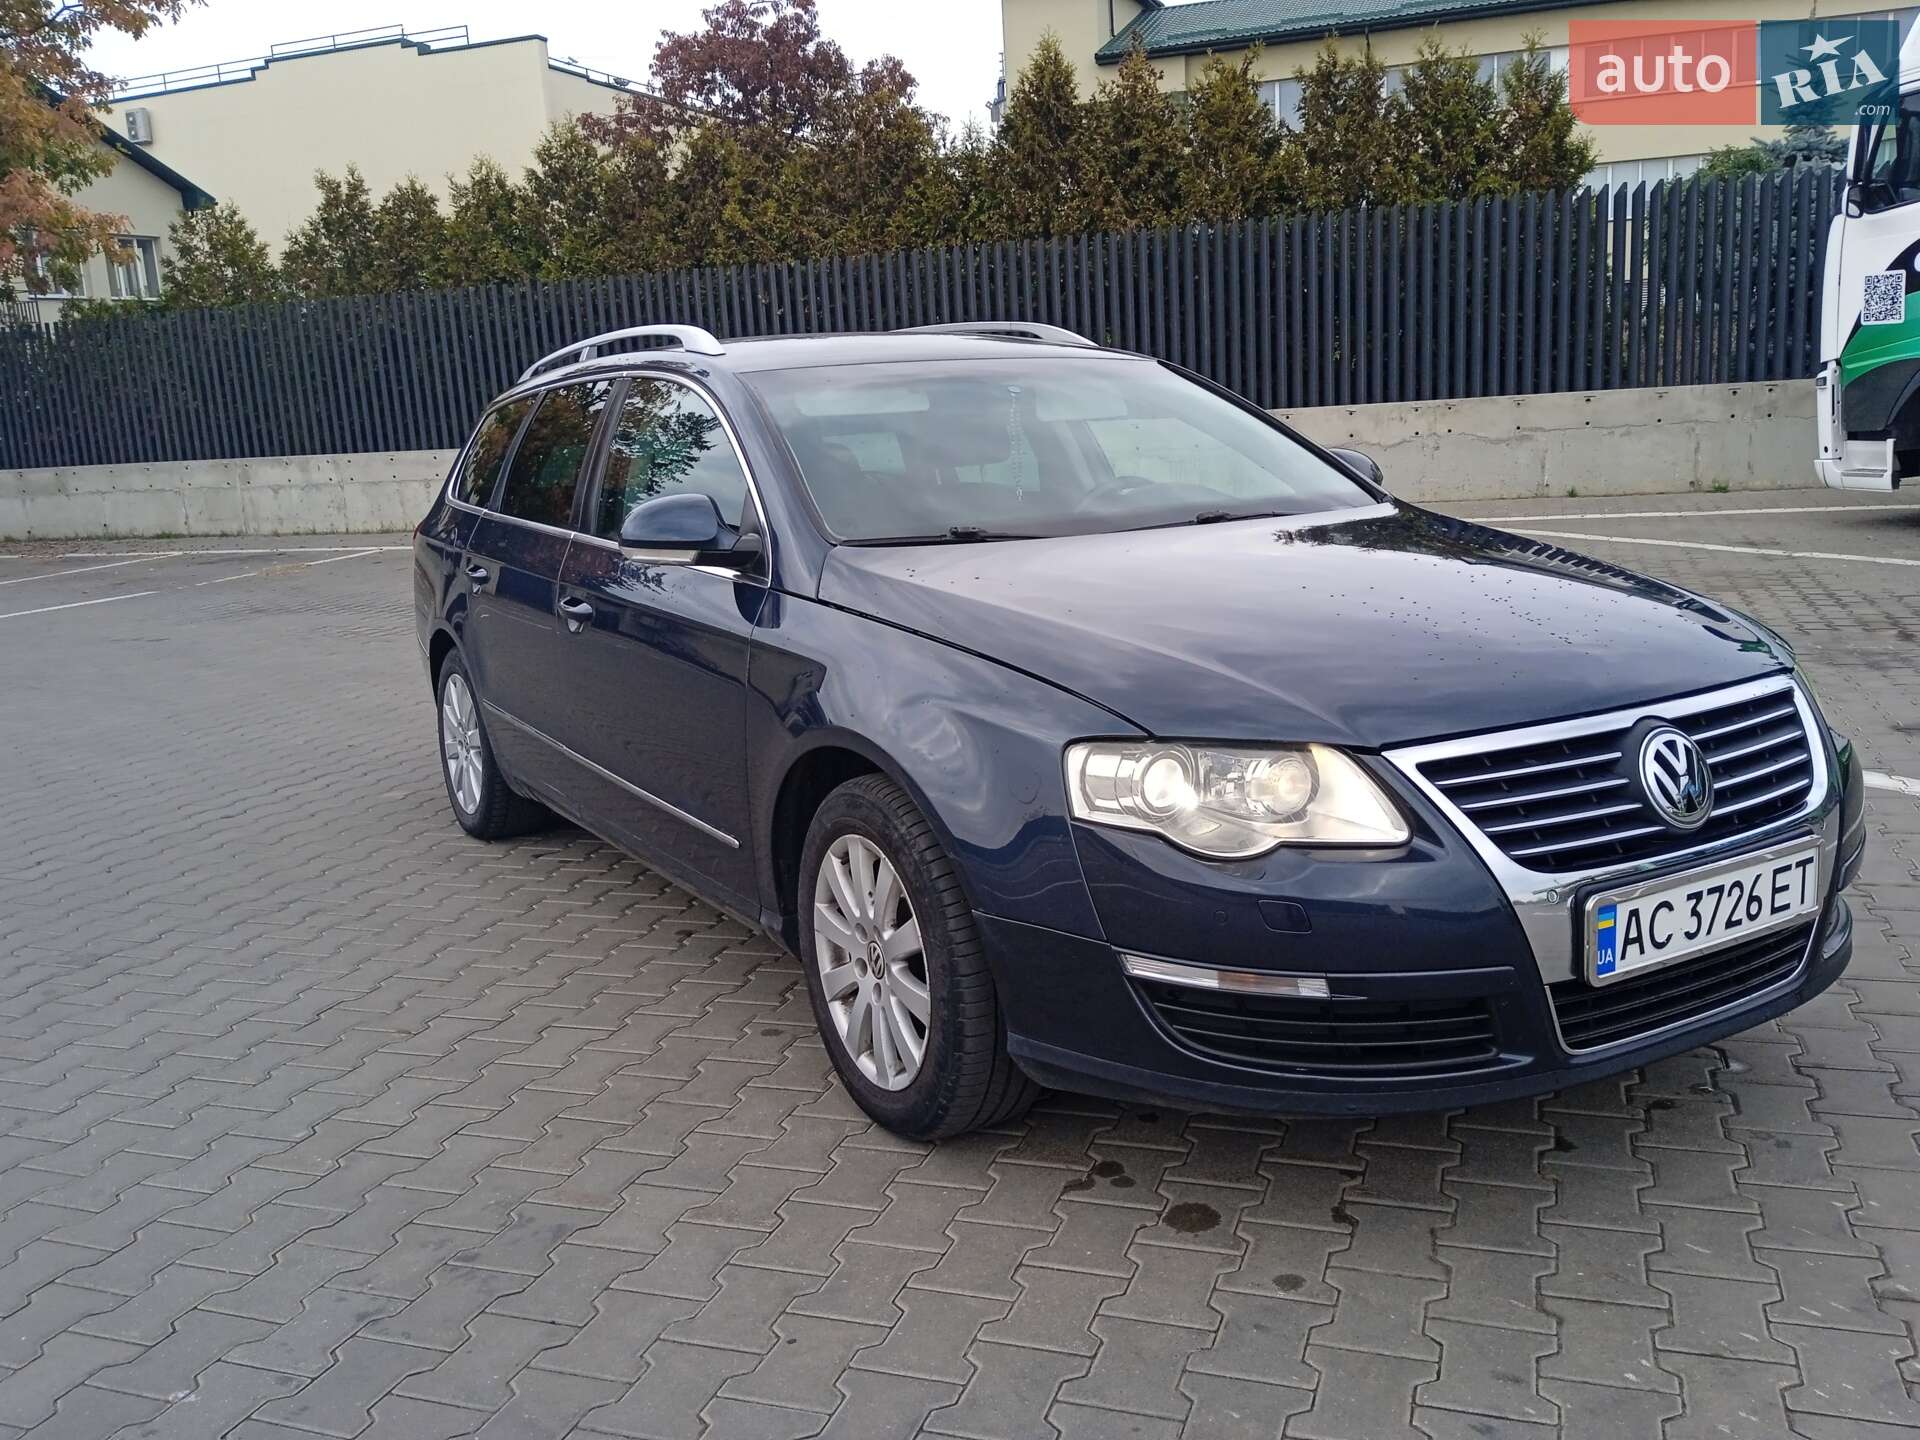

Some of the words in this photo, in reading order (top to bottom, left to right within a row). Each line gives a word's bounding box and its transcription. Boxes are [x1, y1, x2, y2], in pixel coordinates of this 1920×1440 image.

[1620, 900, 1675, 961] AC
[1683, 873, 1763, 941] 3726
[1770, 855, 1815, 915] ET
[1597, 947, 1614, 965] UA
